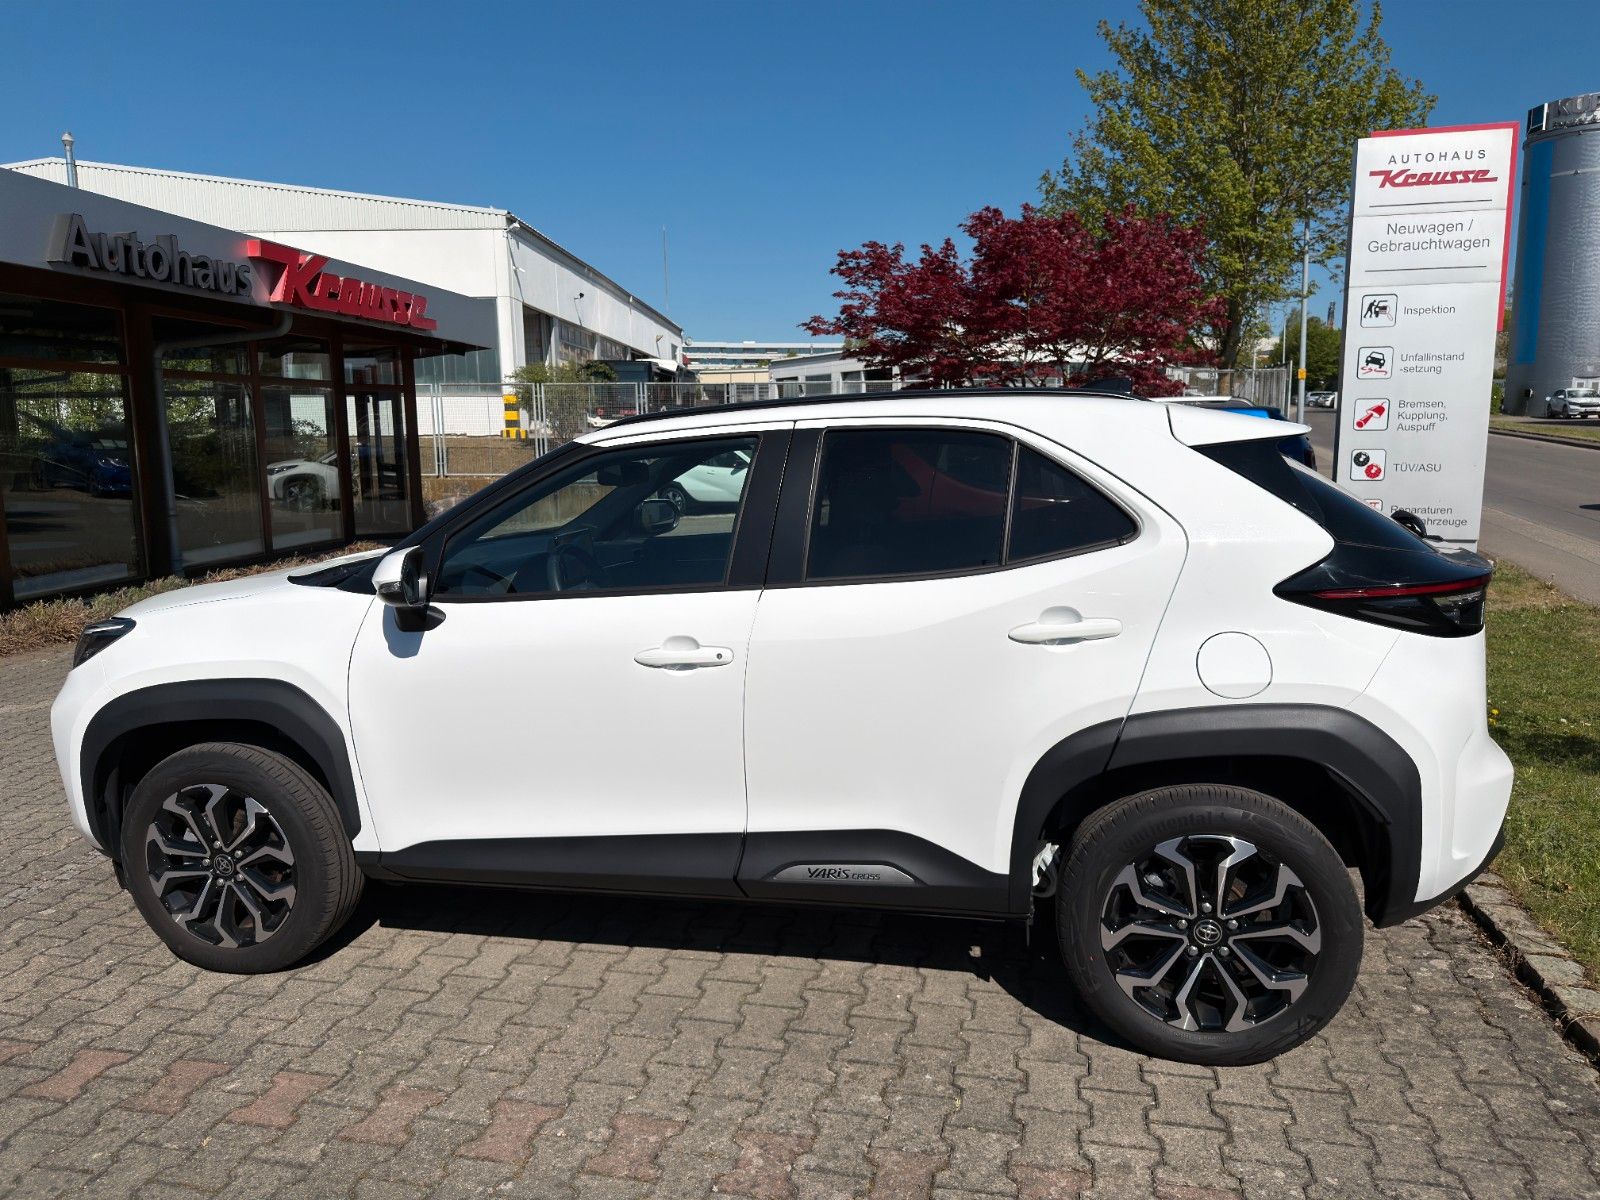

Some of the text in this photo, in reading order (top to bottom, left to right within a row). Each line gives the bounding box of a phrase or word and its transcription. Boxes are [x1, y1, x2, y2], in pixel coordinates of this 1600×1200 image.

[1388, 150, 1487, 165] AUTOHAUS
[1369, 169, 1499, 188] Krausse
[1387, 219, 1474, 236] Neuwagen /
[1368, 237, 1491, 253] Gebrauchtwagen
[48, 212, 438, 331] Autohaus Krausse
[1403, 305, 1456, 317] Inspektion
[1400, 352, 1465, 362] Unfallinstand
[1400, 364, 1442, 375] -setzung
[1398, 400, 1447, 409] Bremsen,
[1397, 411, 1448, 421] Kupplung,
[1397, 422, 1436, 433] Auspuff
[1393, 462, 1442, 473] TÜV/ASU
[1424, 517, 1468, 528] ahrzeuge
[851, 872, 881, 881] CROSS
